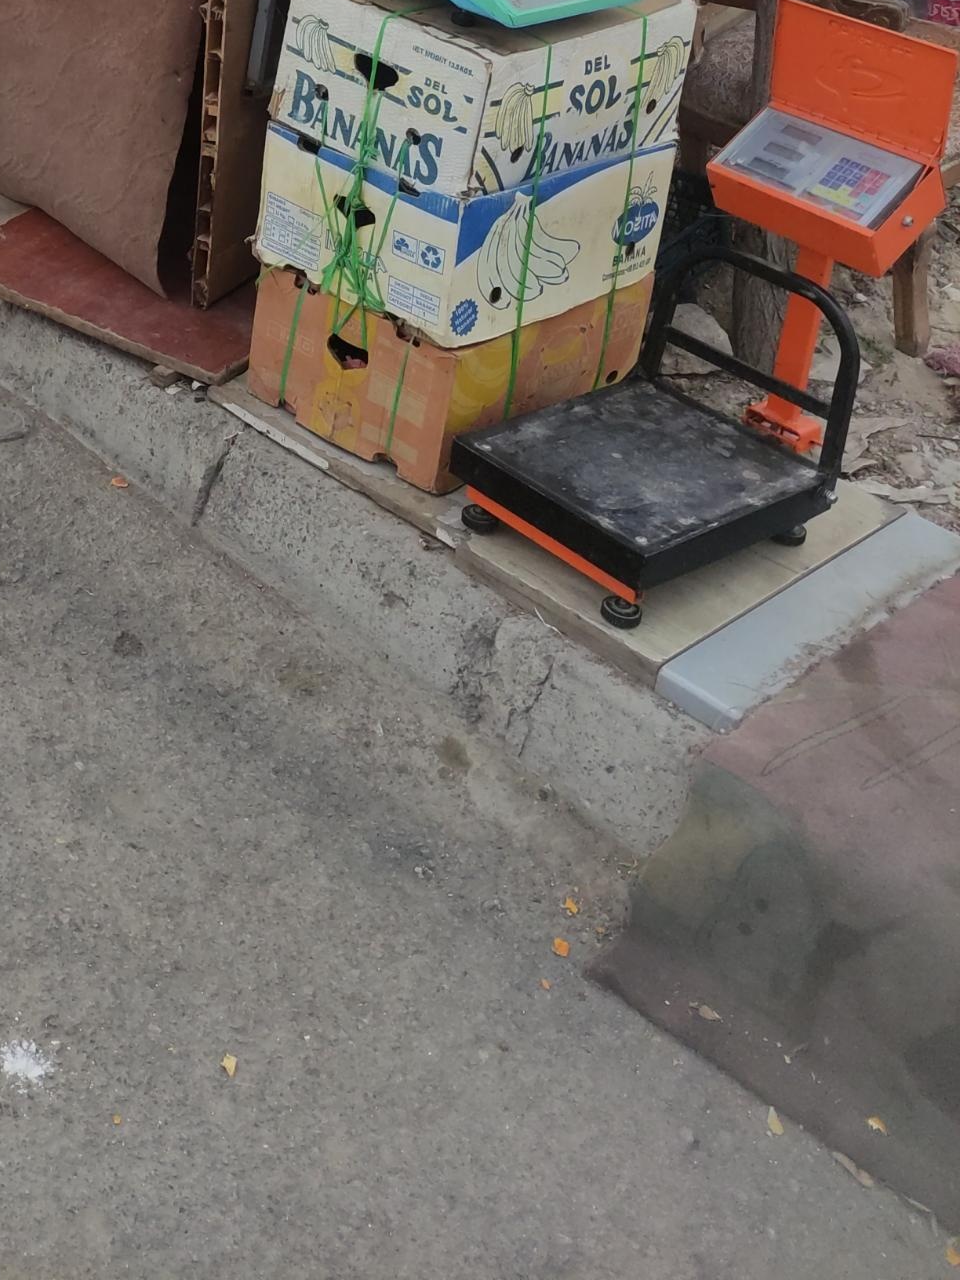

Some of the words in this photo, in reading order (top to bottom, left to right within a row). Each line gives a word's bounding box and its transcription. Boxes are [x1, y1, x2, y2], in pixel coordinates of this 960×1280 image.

[424, 76, 449, 95] DEL
[584, 54, 612, 77] DEL
[406, 84, 459, 124] SOL
[566, 74, 623, 117] SOL
[287, 68, 444, 186] BANANAS
[519, 116, 635, 184] BANANAS
